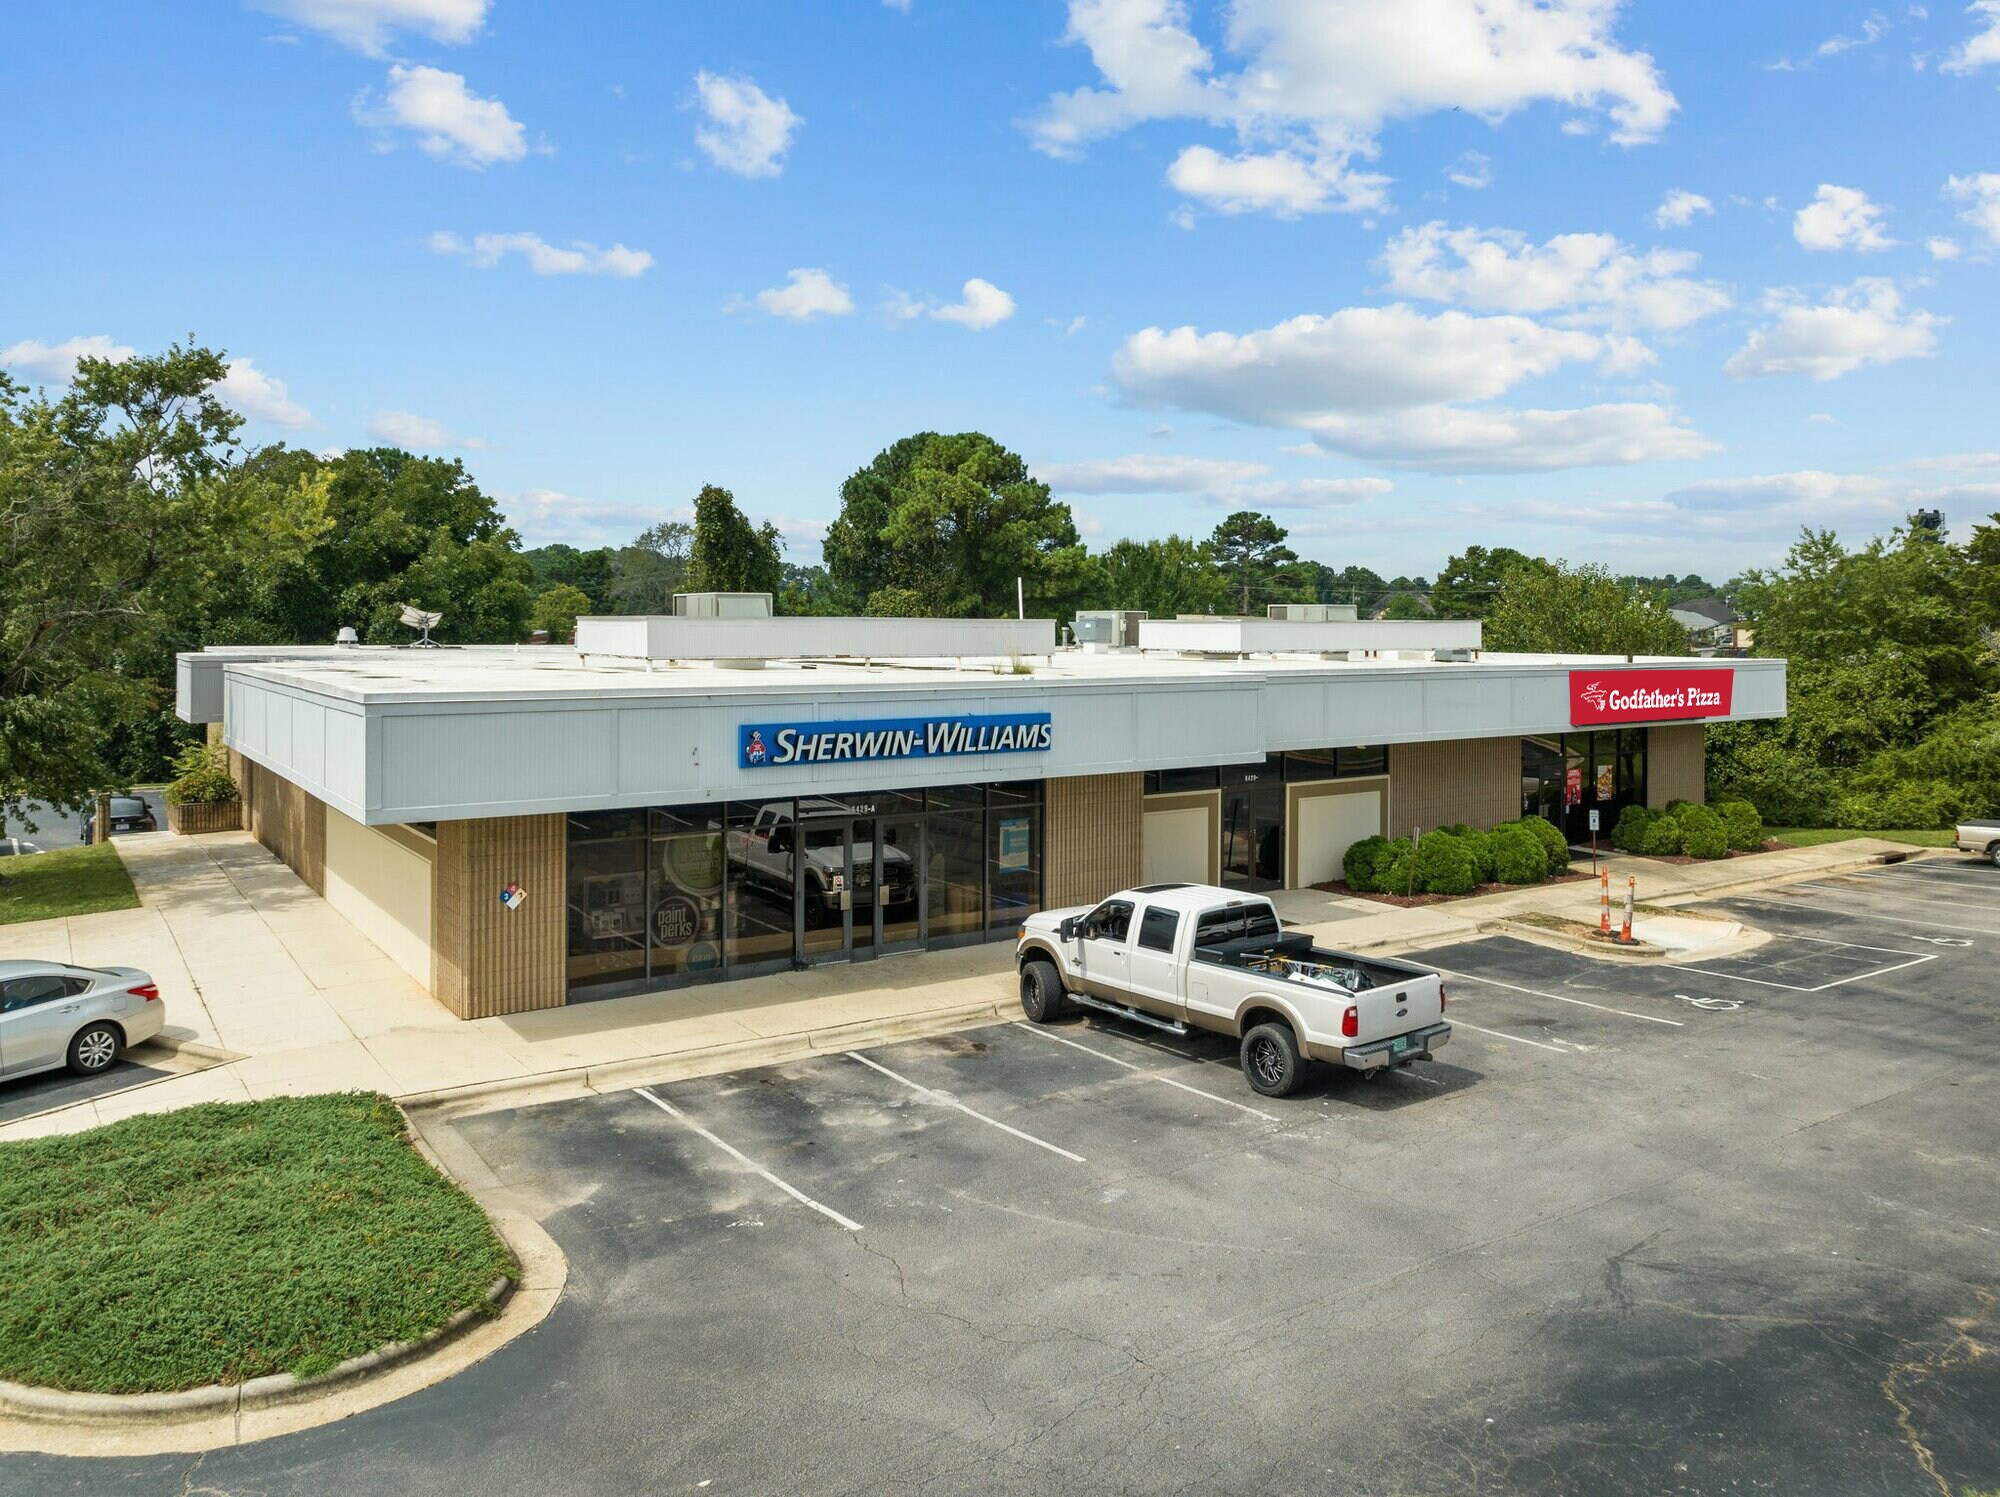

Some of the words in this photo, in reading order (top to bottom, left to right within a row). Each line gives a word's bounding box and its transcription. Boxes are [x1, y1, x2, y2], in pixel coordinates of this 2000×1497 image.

[1609, 688, 1684, 710] Godfather's
[1687, 687, 1721, 706] Pizza
[773, 722, 1052, 763] SHERWIN-WILLIAMS
[657, 906, 687, 927] paint
[660, 921, 692, 940] perks
